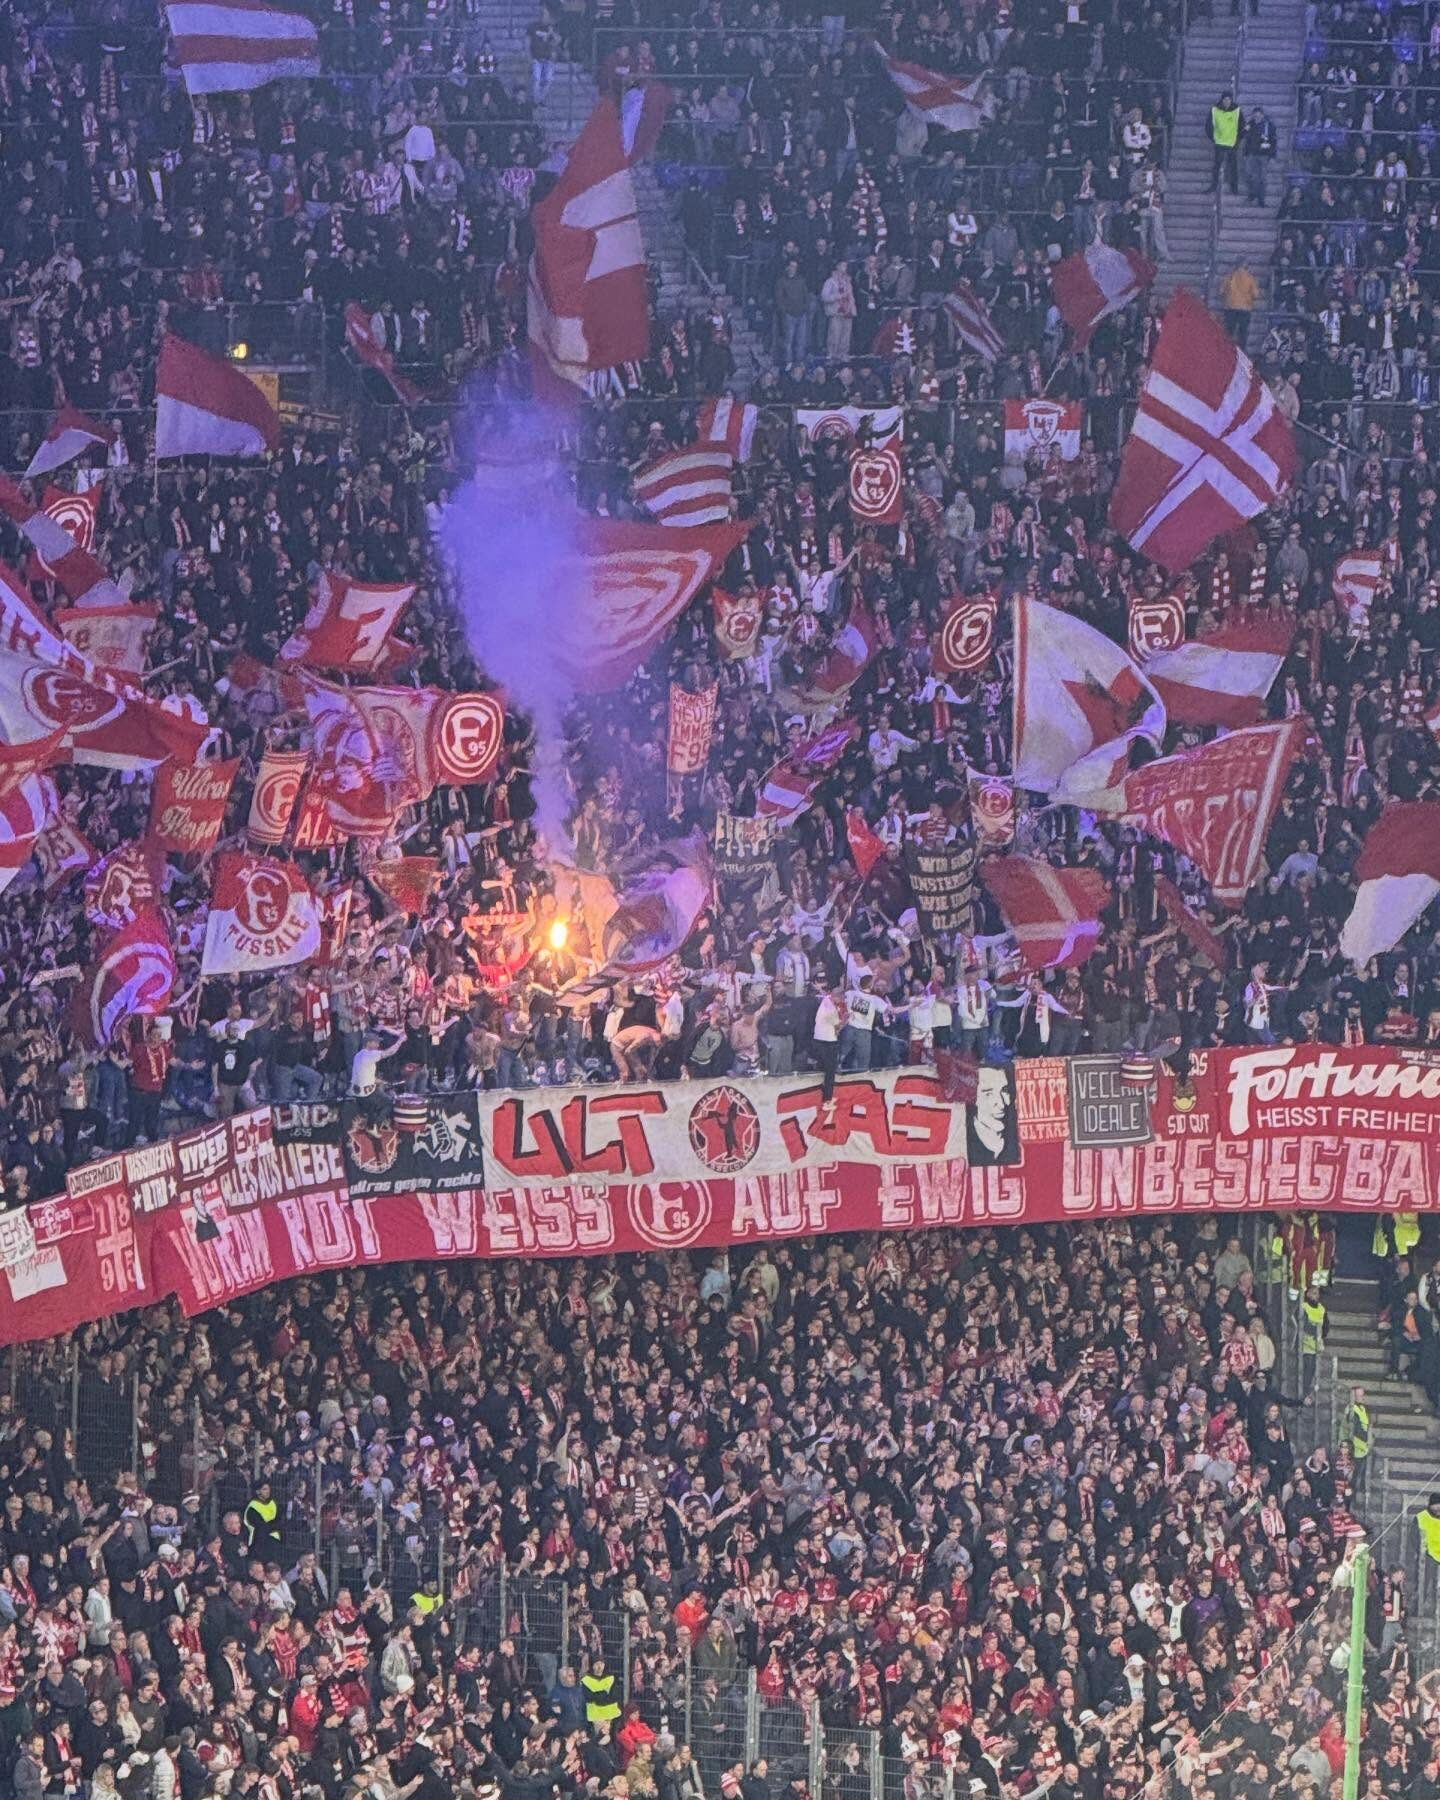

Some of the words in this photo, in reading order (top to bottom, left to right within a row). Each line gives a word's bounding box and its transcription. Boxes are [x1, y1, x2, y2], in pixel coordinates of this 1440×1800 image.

[1016, 1079, 1068, 1118] KRAFT
[1084, 1103, 1140, 1133] IDEALE
[1257, 1106, 1332, 1128] HEISST
[1337, 1107, 1440, 1134] FREIHEI
[280, 1143, 344, 1190] LIEBE
[277, 1188, 381, 1271] ROT
[416, 1184, 614, 1255] WEISS
[731, 1162, 841, 1237] AUF
[877, 1160, 1026, 1228] EWIG
[1062, 1137, 1440, 1213] UNBESIEGBA
